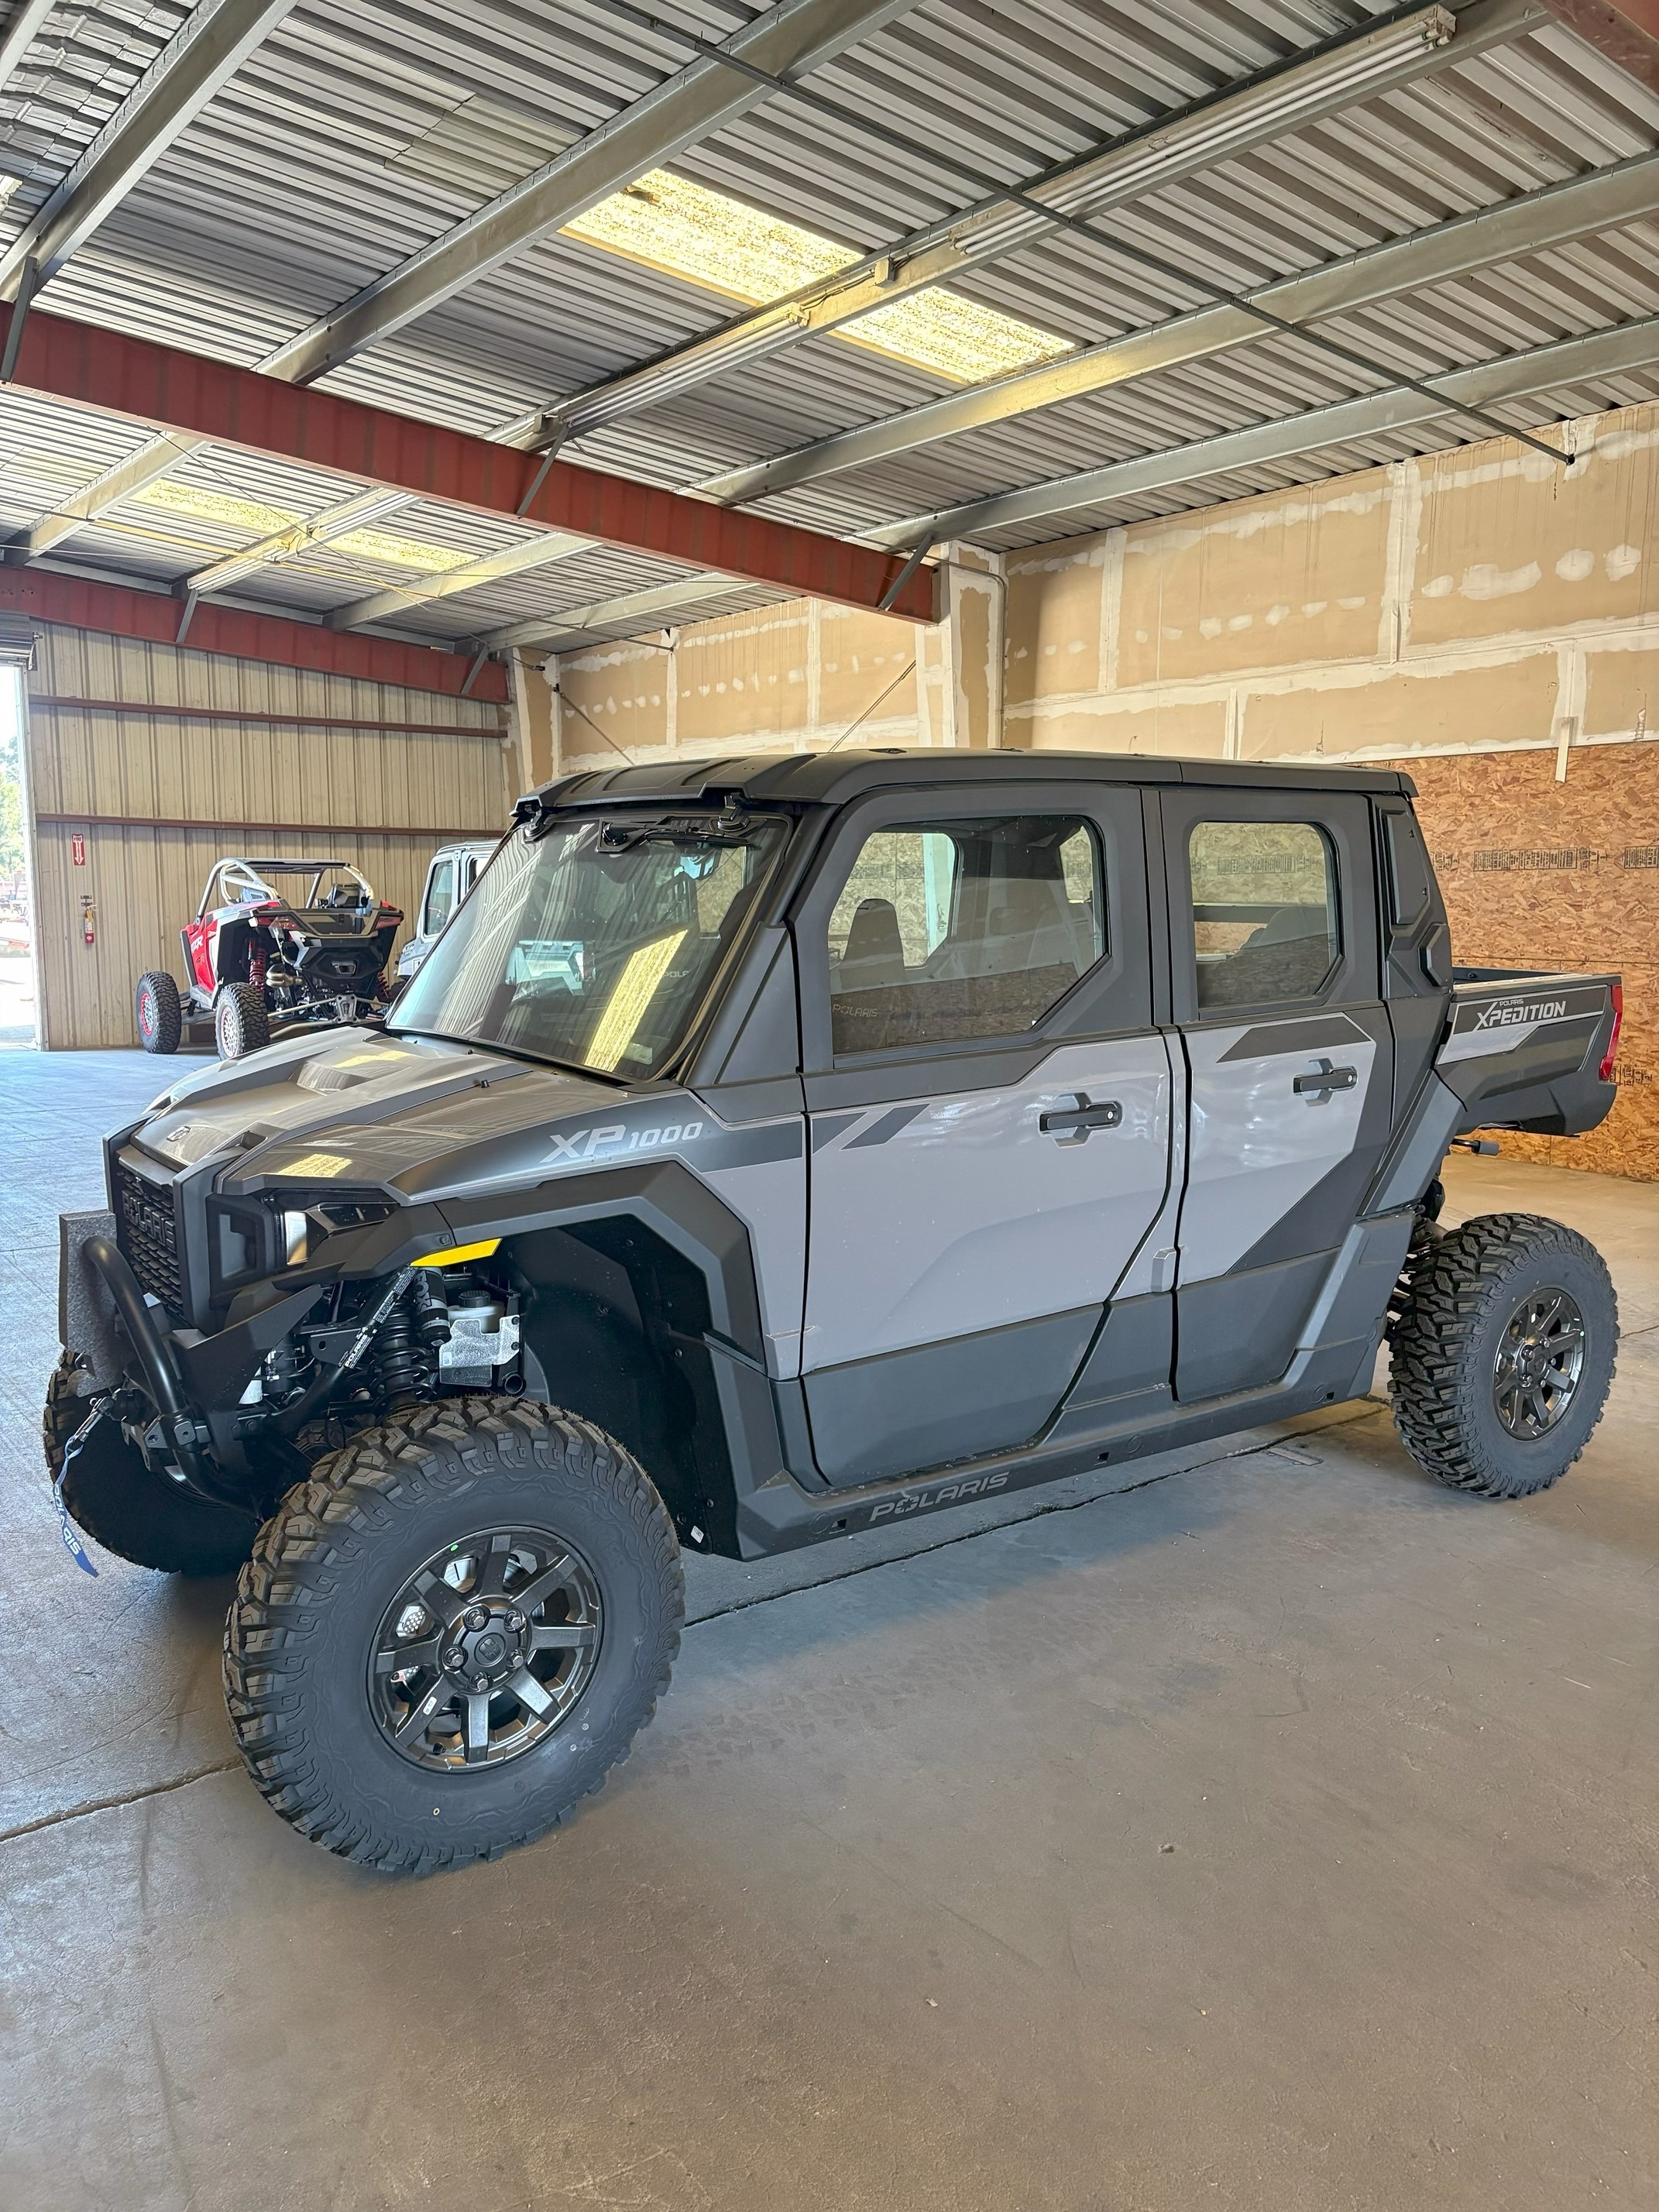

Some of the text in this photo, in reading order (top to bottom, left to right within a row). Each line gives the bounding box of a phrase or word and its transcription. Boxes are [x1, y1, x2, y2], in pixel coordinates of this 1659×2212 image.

[833, 1004, 878, 1018] POLARIS
[1472, 1001, 1566, 1032] XPEDITION
[1499, 998, 1524, 1007] POLARIS
[539, 1122, 703, 1164] XP 1000
[414, 1270, 432, 1314] FOX
[345, 1334, 368, 1367] POLARIS
[869, 1472, 1010, 1523] POLARIS
